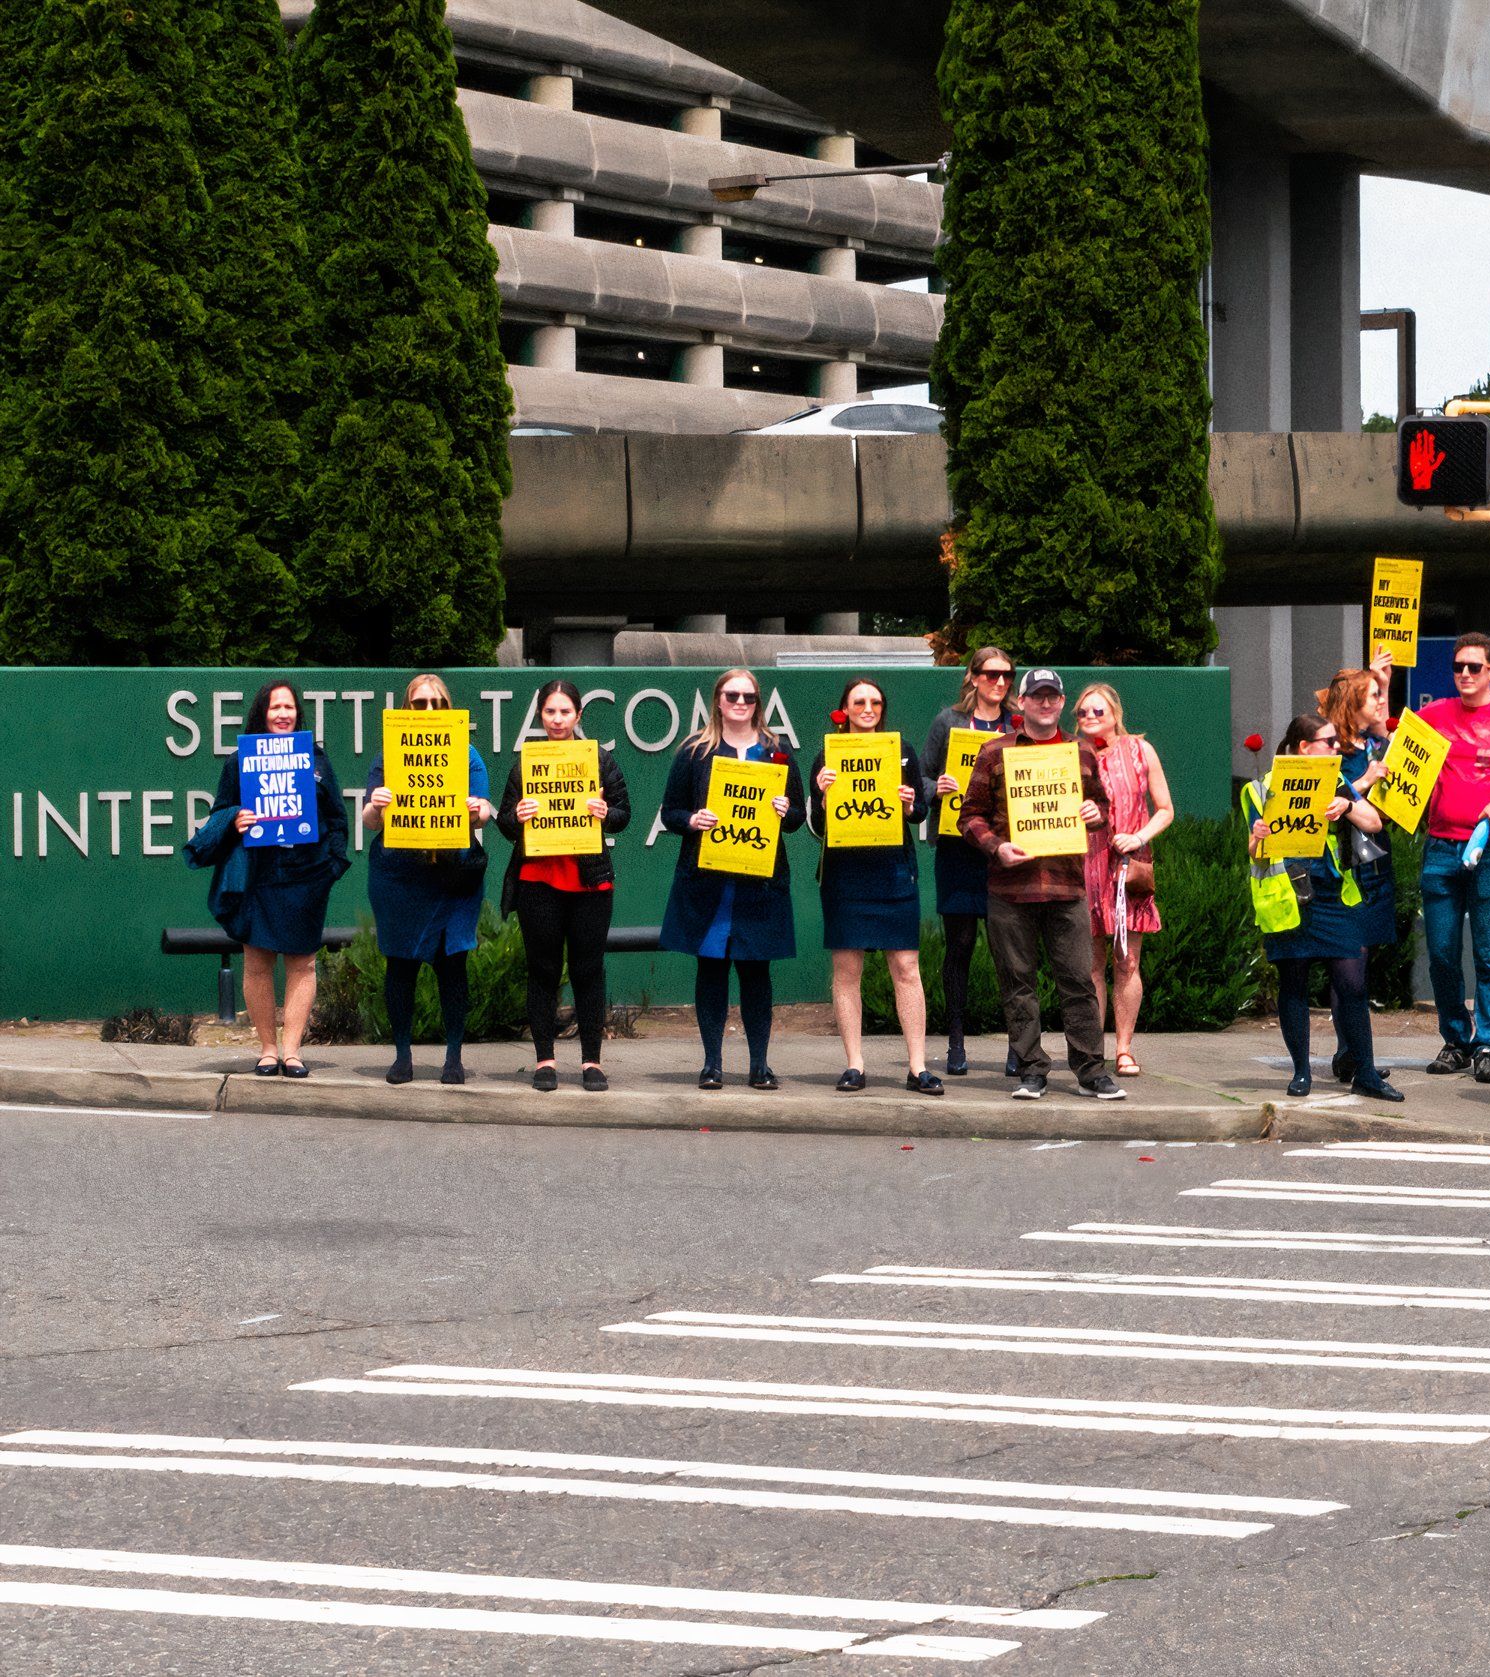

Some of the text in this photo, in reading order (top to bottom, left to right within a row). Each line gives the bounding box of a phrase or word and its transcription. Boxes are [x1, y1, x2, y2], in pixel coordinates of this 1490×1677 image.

[1384, 612, 1402, 624] NEW
[1373, 627, 1413, 642] CONTRACT
[257, 737, 294, 755] FLIGHT
[401, 733, 451, 746] ALASKA
[1402, 736, 1431, 763] READY
[243, 753, 311, 773] ATTENDANTS
[403, 753, 448, 767] MAKES
[841, 758, 881, 772] READY
[1403, 757, 1420, 777] FOR
[532, 764, 549, 777] MY
[1015, 769, 1032, 781] MY
[259, 772, 296, 795] SAVE
[526, 780, 597, 795] DESERVES A
[852, 778, 876, 792] FOR
[1010, 782, 1079, 798] DESERVES A
[1282, 778, 1321, 791] READY
[1390, 771, 1421, 807] HAOS
[723, 783, 766, 802] READY
[255, 795, 302, 818] LIVES!
[396, 794, 456, 808] WE CAN'T
[549, 798, 575, 811] NEW
[835, 797, 894, 820] CHAOS
[1033, 800, 1058, 813] NEW
[1289, 797, 1311, 809] FOR
[732, 804, 756, 820] FOR
[391, 814, 462, 829] MAKE RENT
[531, 814, 594, 829] CONTRACT
[1017, 816, 1078, 832] CONTRACT
[1269, 814, 1322, 834] CHAOS
[710, 824, 770, 850] CHAOS
